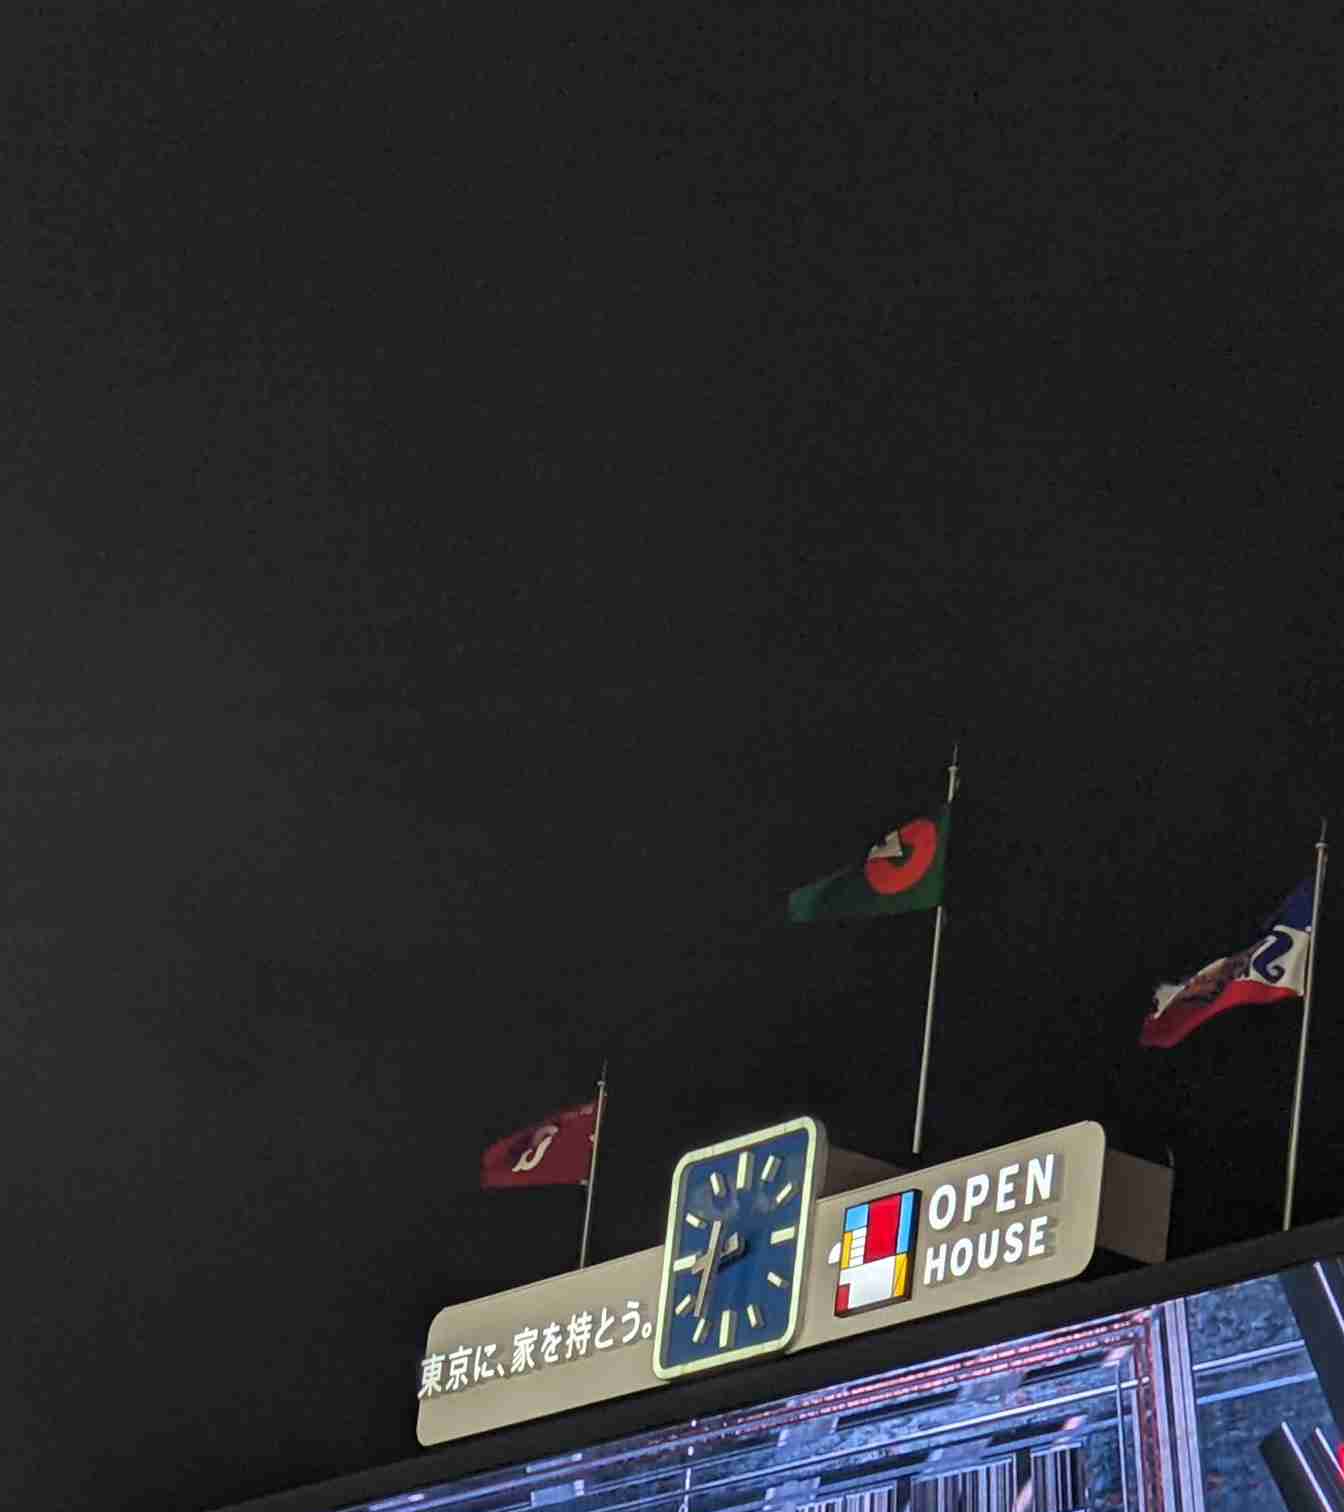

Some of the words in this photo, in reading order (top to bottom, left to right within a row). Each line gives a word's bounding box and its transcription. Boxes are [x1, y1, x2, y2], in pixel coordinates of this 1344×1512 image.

[928, 1154, 1056, 1229] OPEN
[923, 1216, 1050, 1283] HOUSE
[418, 1301, 652, 1398] 東京に、家を持とう。
